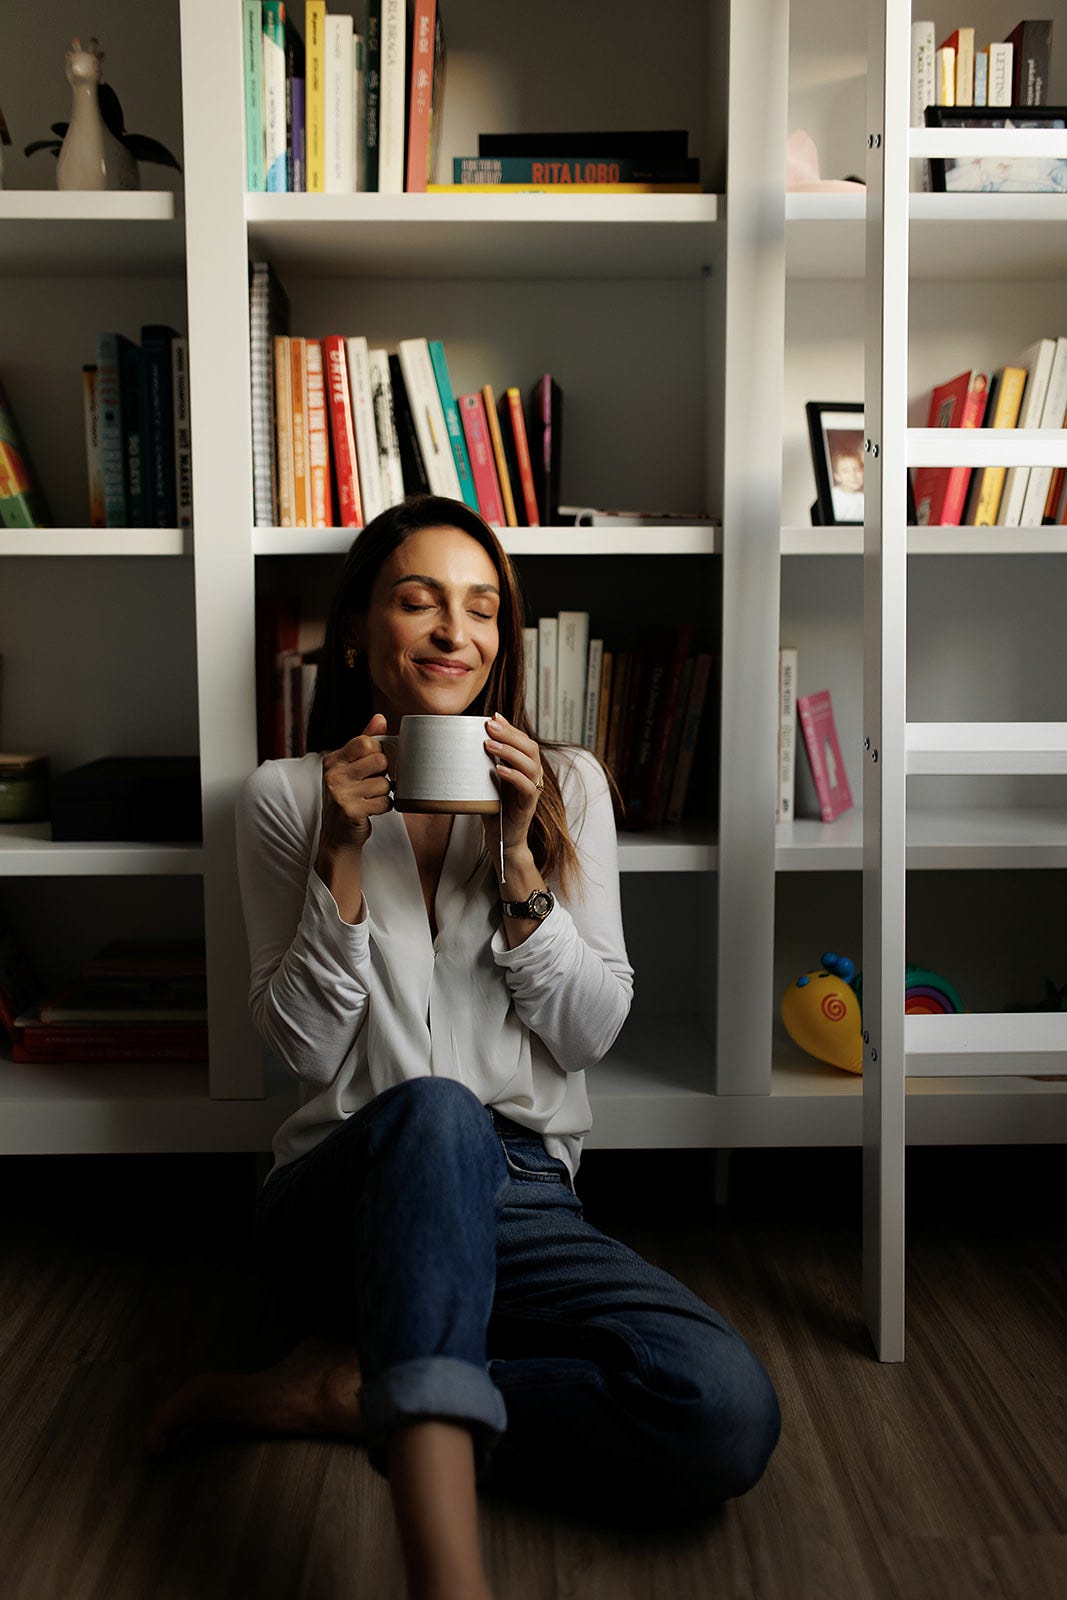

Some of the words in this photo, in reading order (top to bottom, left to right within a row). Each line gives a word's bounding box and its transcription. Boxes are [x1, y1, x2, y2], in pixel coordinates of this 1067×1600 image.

[531, 161, 572, 184] RITA
[575, 162, 620, 184] LOBO
[330, 350, 346, 403] DRIVE
